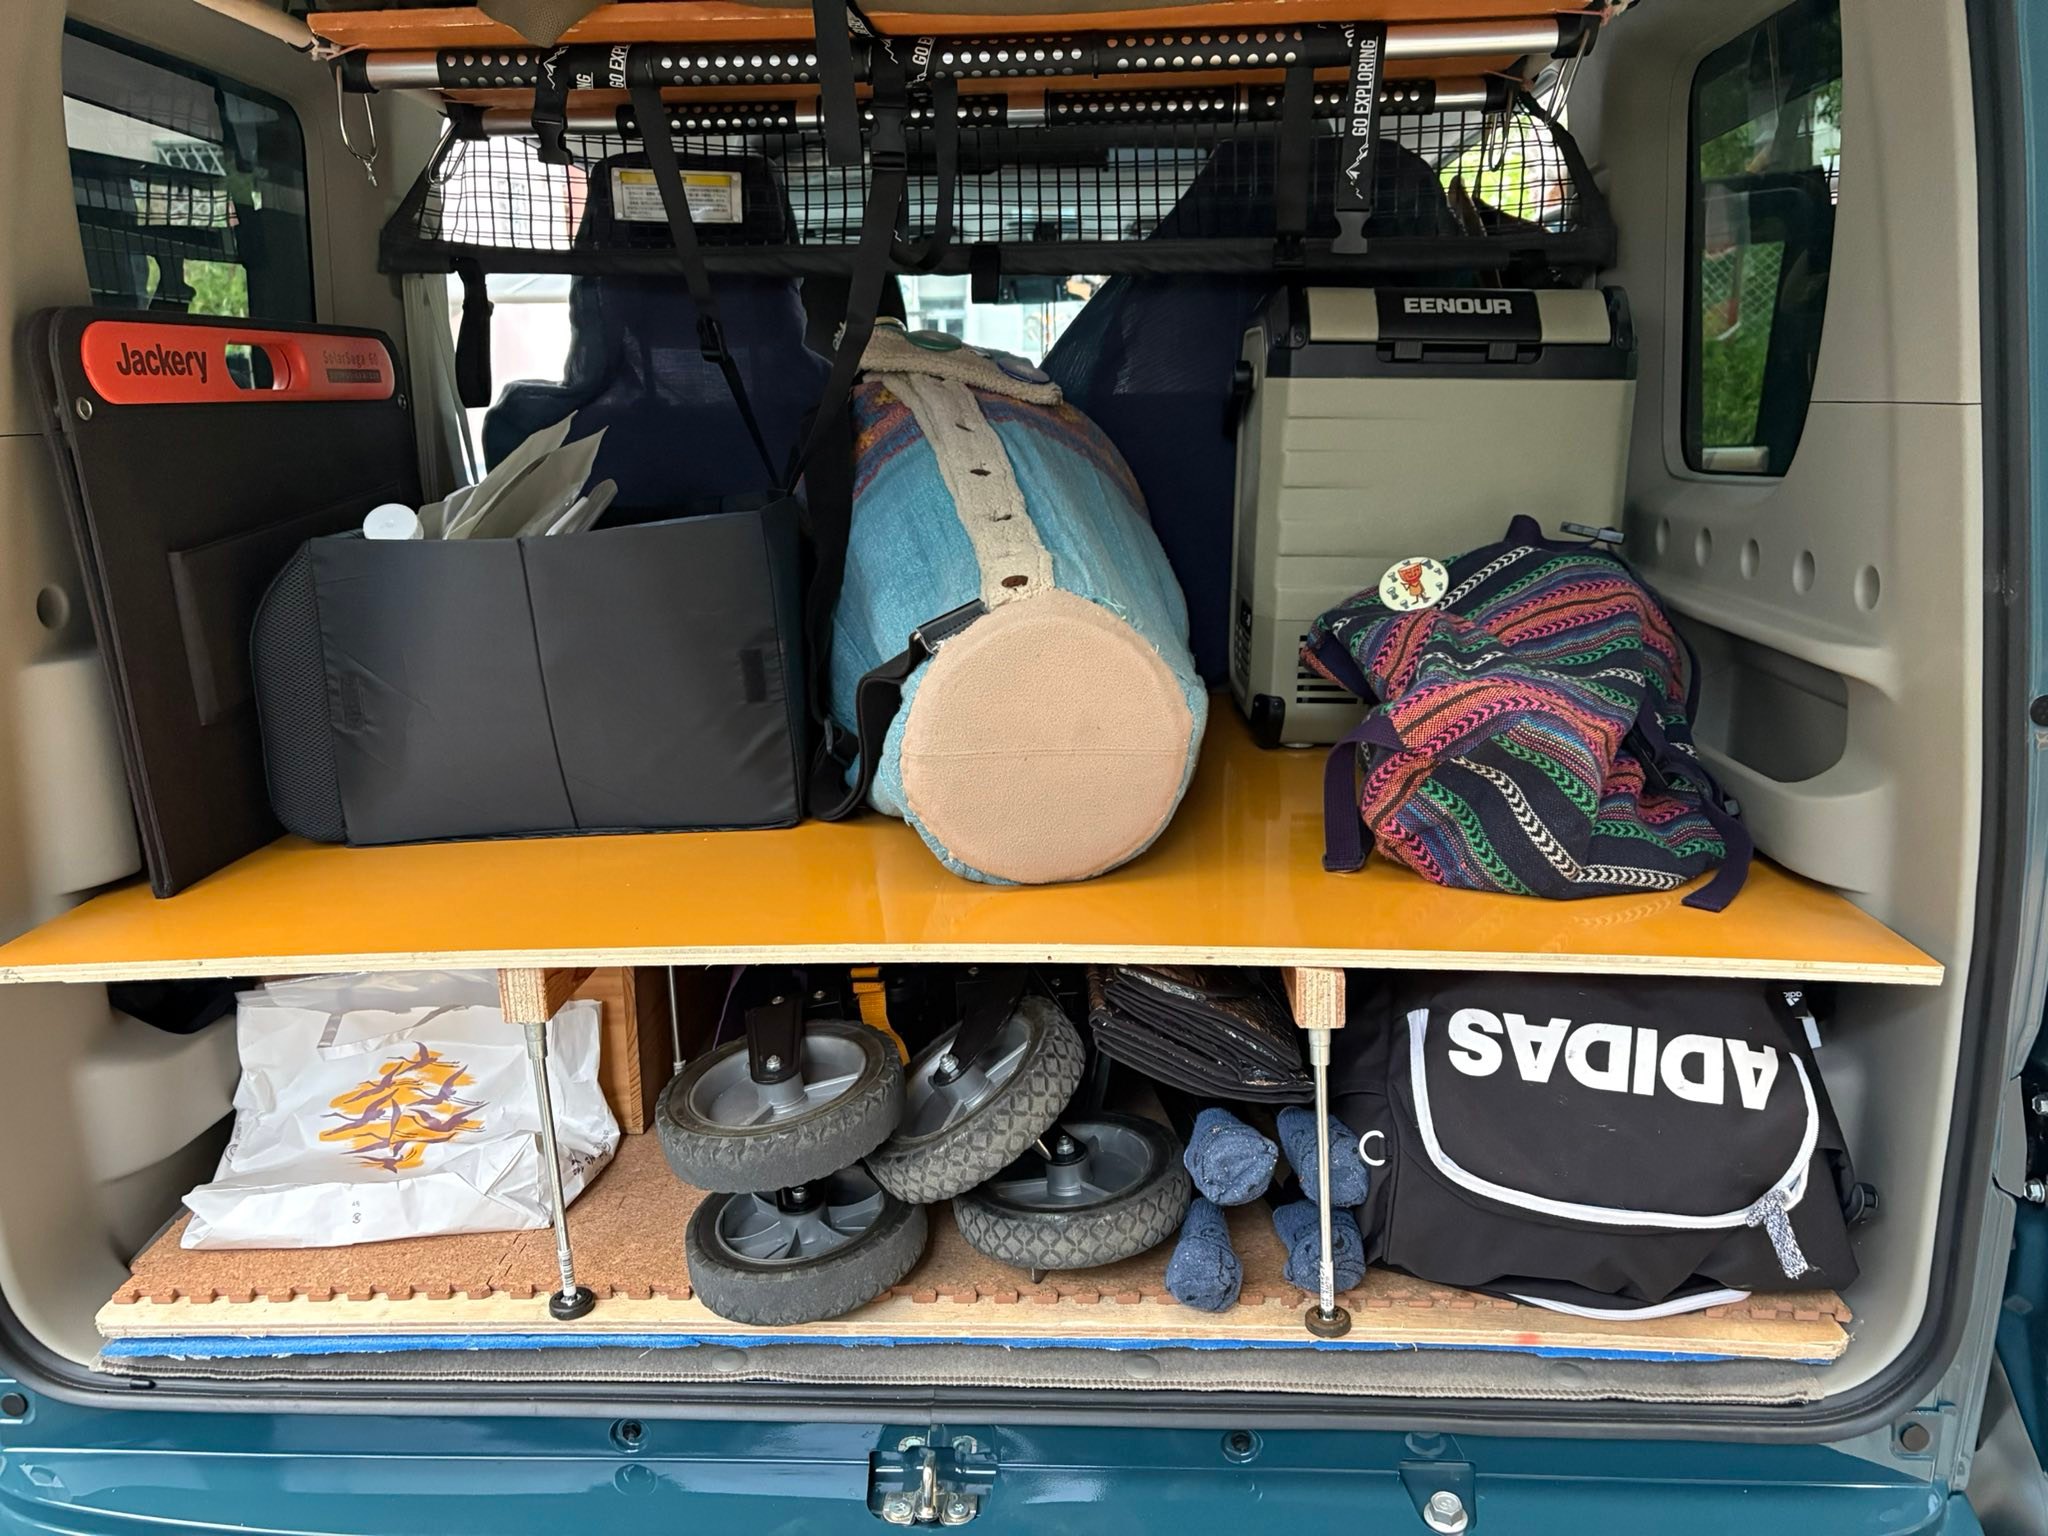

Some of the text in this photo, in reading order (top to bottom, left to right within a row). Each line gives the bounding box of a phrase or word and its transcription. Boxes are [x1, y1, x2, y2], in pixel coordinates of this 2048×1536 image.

[911, 46, 929, 65] GO
[608, 73, 625, 89] GO
[1352, 39, 1376, 137] GO EXPLORING
[1403, 297, 1513, 314] EENOUR
[116, 342, 208, 384] Jackery
[1447, 1007, 1780, 1111] ADIDAS
